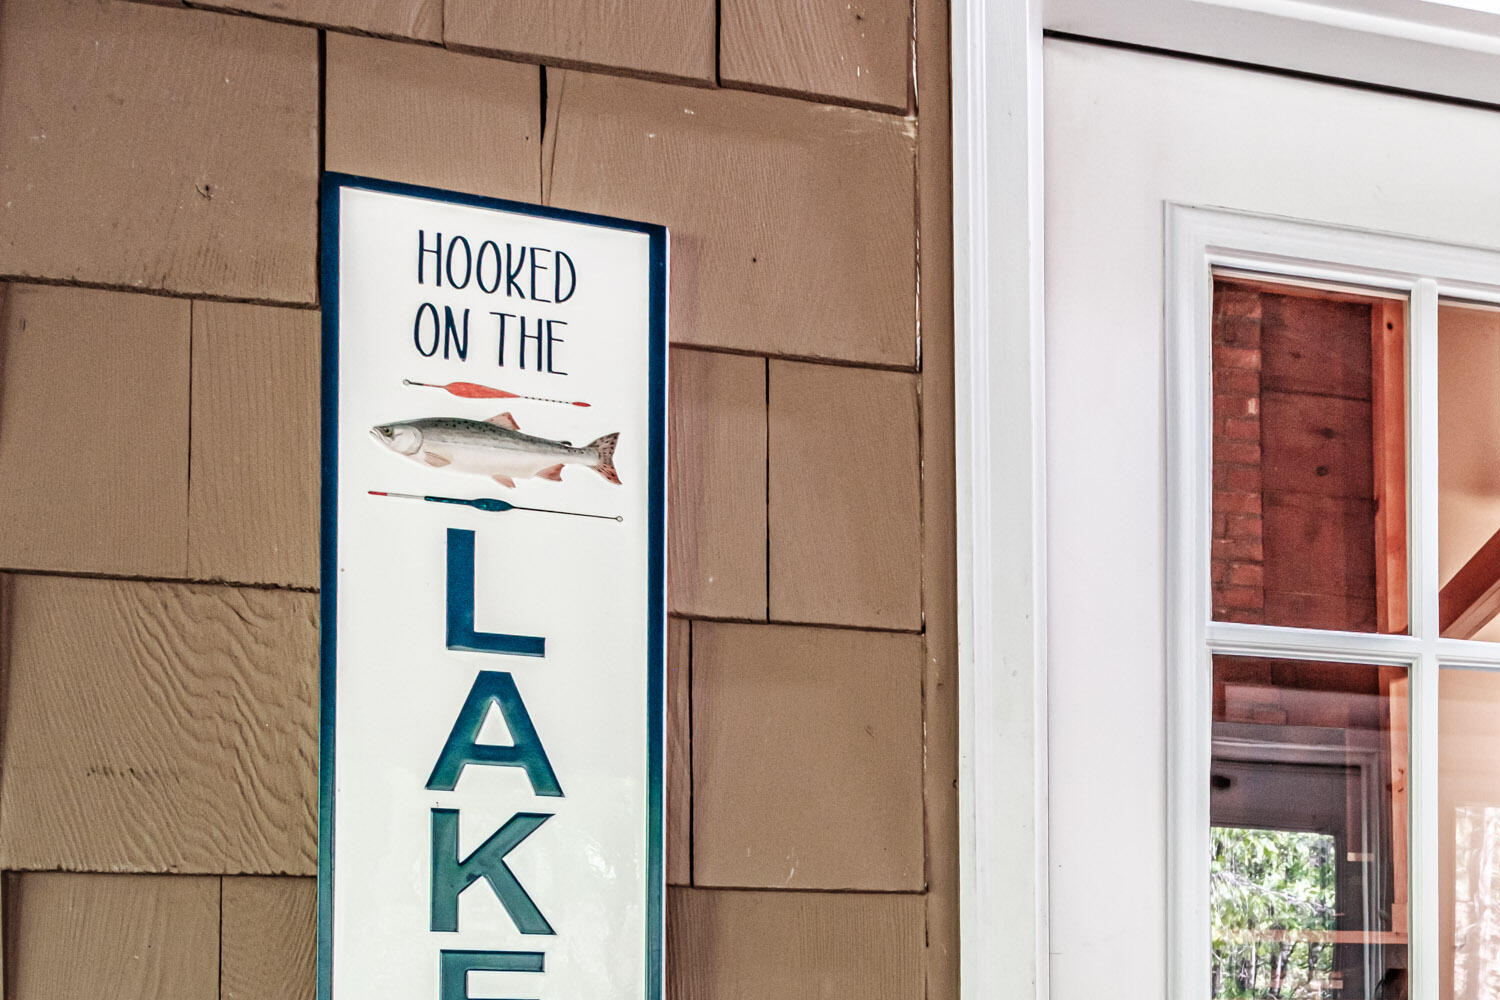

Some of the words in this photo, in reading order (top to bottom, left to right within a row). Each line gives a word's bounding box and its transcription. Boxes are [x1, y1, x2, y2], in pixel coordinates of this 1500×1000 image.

[417, 229, 577, 304] HOOKED
[413, 302, 470, 362] ON
[489, 311, 569, 376] THE
